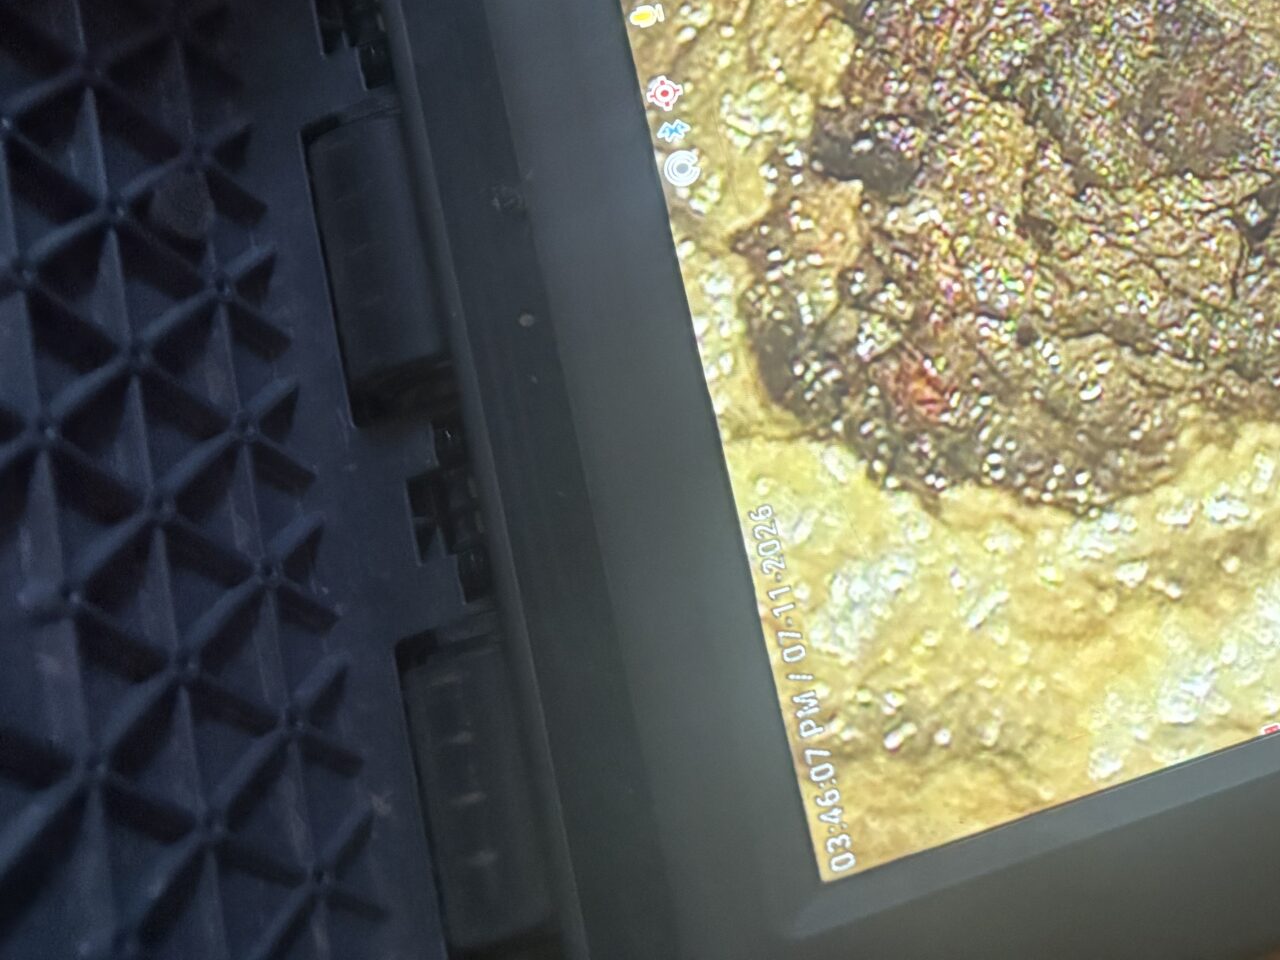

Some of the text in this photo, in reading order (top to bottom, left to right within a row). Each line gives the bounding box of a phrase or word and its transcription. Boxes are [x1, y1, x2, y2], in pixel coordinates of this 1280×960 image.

[748, 504, 856, 872] 03:46:07 PM / 07-11-2026
